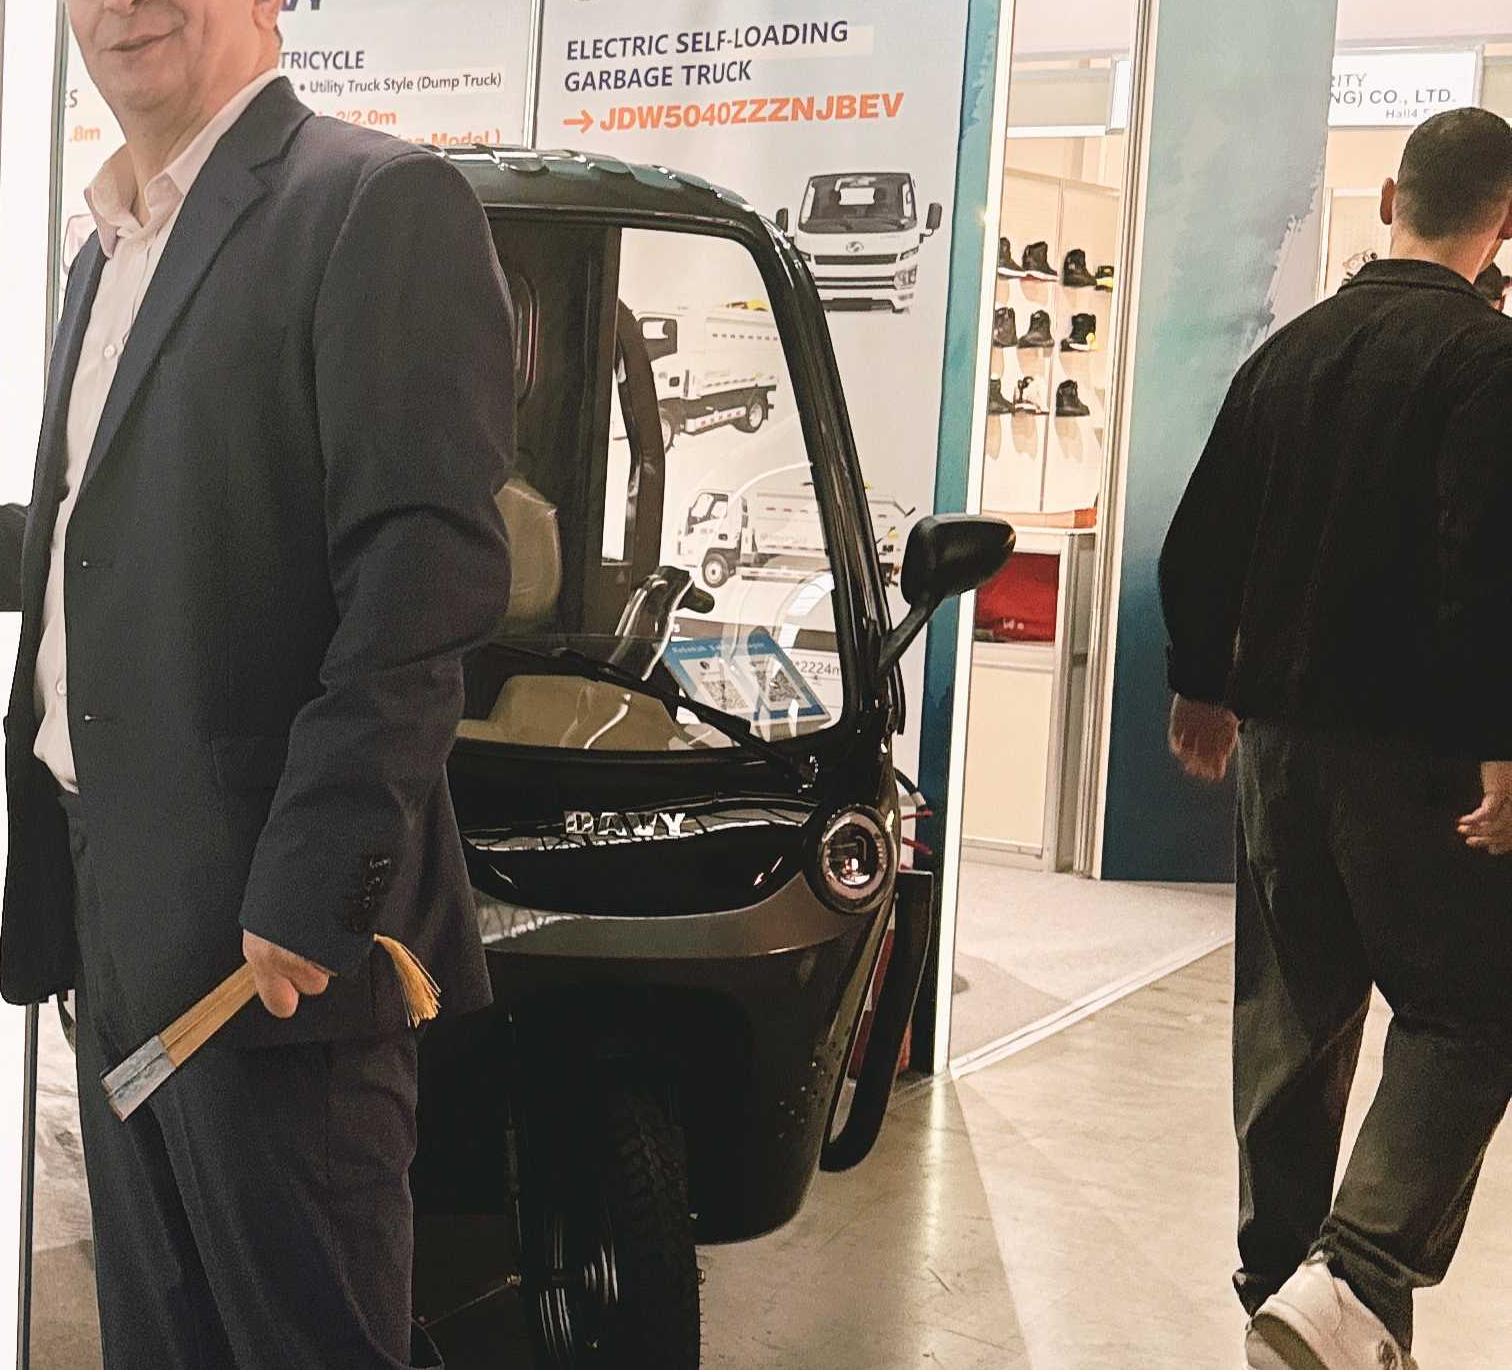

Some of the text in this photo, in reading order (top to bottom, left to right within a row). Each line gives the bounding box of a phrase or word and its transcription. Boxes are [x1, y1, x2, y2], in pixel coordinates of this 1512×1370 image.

[566, 20, 849, 61] ELECTRIC SELF-LOADING
[309, 72, 502, 97] Utility Truck Style (Dump Truck)
[564, 59, 753, 93] GARBAGE TRUCK
[564, 811, 686, 836] DAVY
